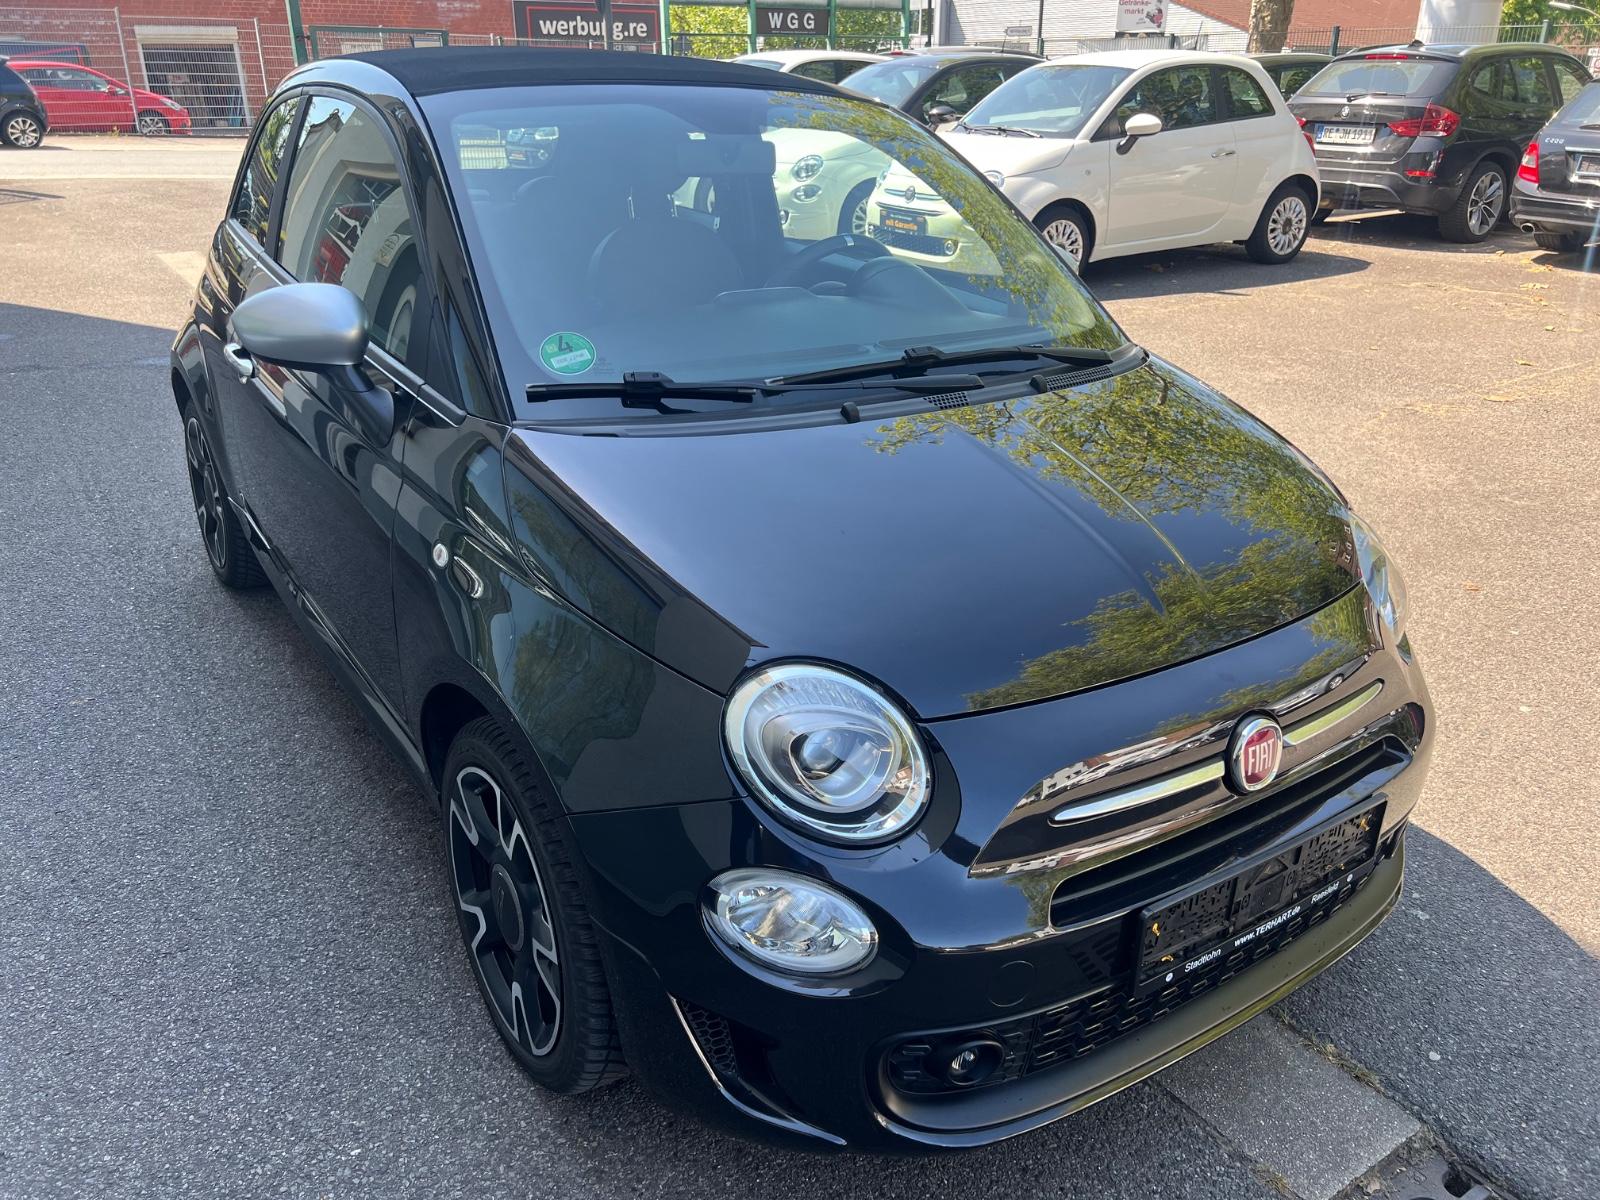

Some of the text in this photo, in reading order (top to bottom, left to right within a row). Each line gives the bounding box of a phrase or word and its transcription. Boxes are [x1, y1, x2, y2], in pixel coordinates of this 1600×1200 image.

[1124, 7, 1144, 15] markt
[1323, 127, 1335, 139] RE
[1247, 738, 1275, 776] FIAT
[1184, 948, 1222, 973] Stadtlohn
[1234, 905, 1301, 947] www.TERHART.de
